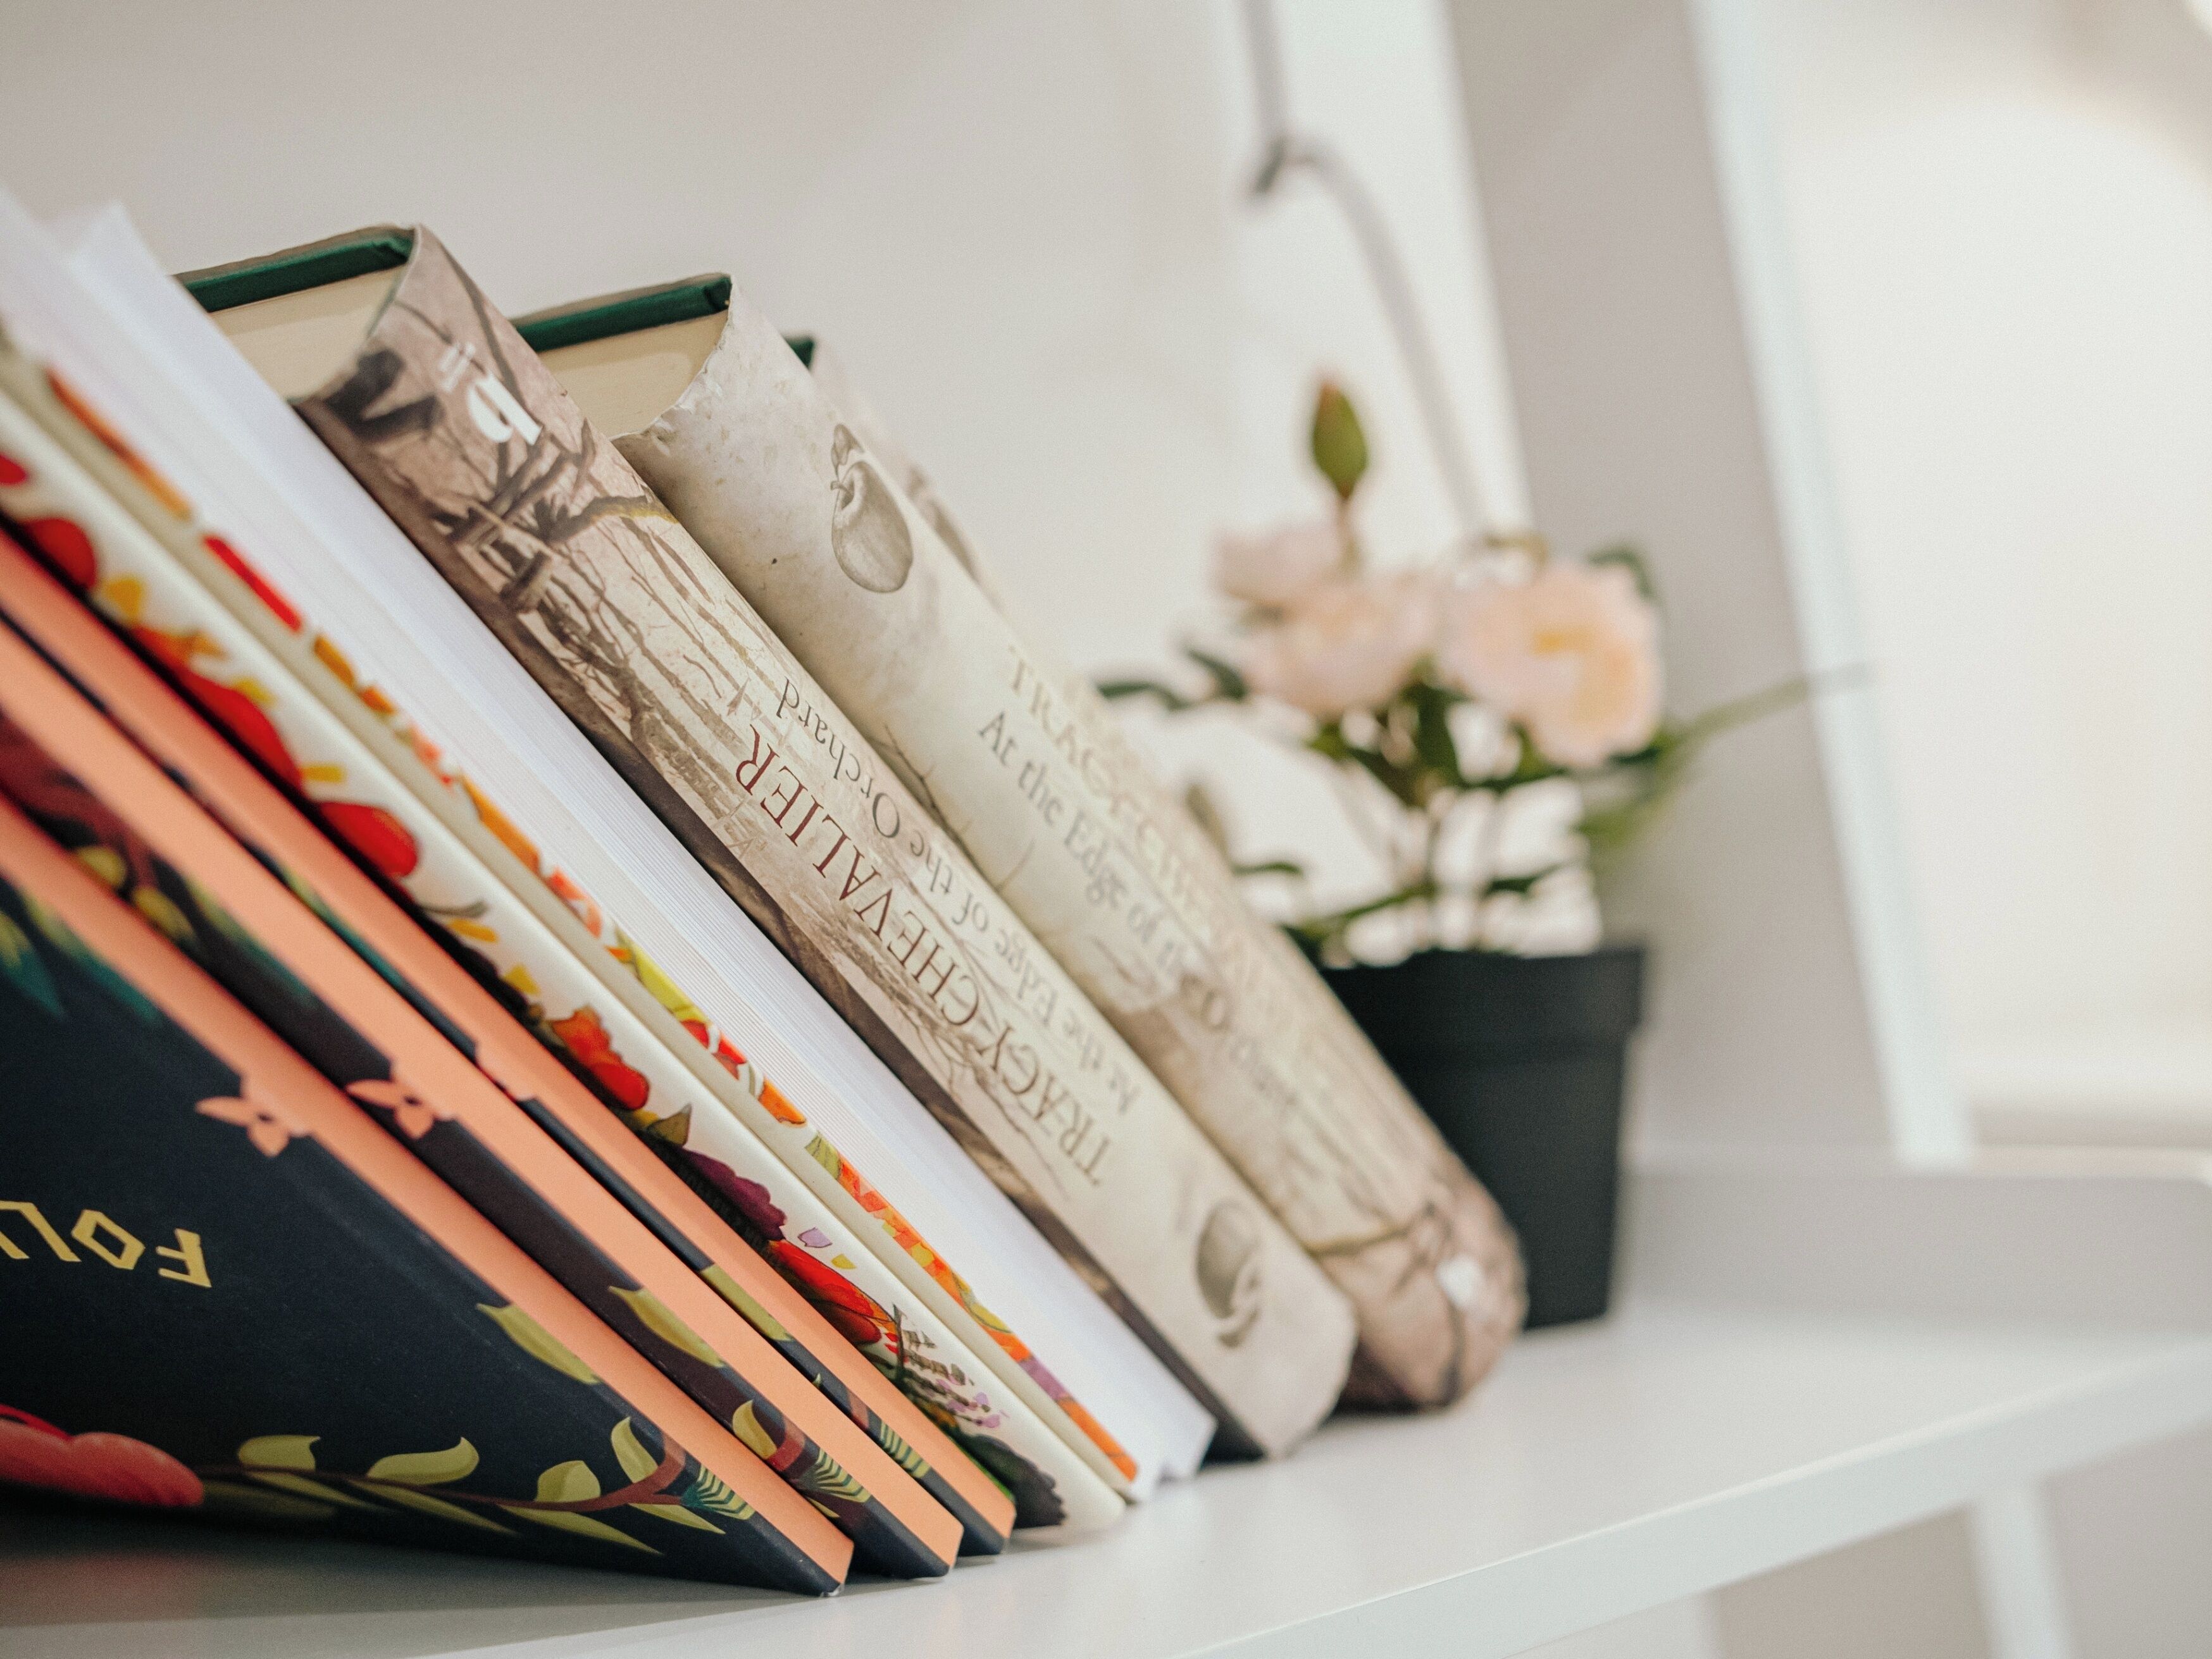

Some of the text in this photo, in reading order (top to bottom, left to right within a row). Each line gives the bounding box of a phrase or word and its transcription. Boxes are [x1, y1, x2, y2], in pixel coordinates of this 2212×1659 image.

[776, 676, 901, 839] Orchard
[978, 710, 1019, 767] At
[1017, 759, 1066, 828] the
[1064, 807, 1130, 909] Edge
[909, 829, 954, 895] the
[735, 724, 1111, 1187] TRACY CHEVALIER
[952, 892, 989, 933] of
[994, 928, 1058, 1028] Edge
[1063, 1016, 1106, 1072] the
